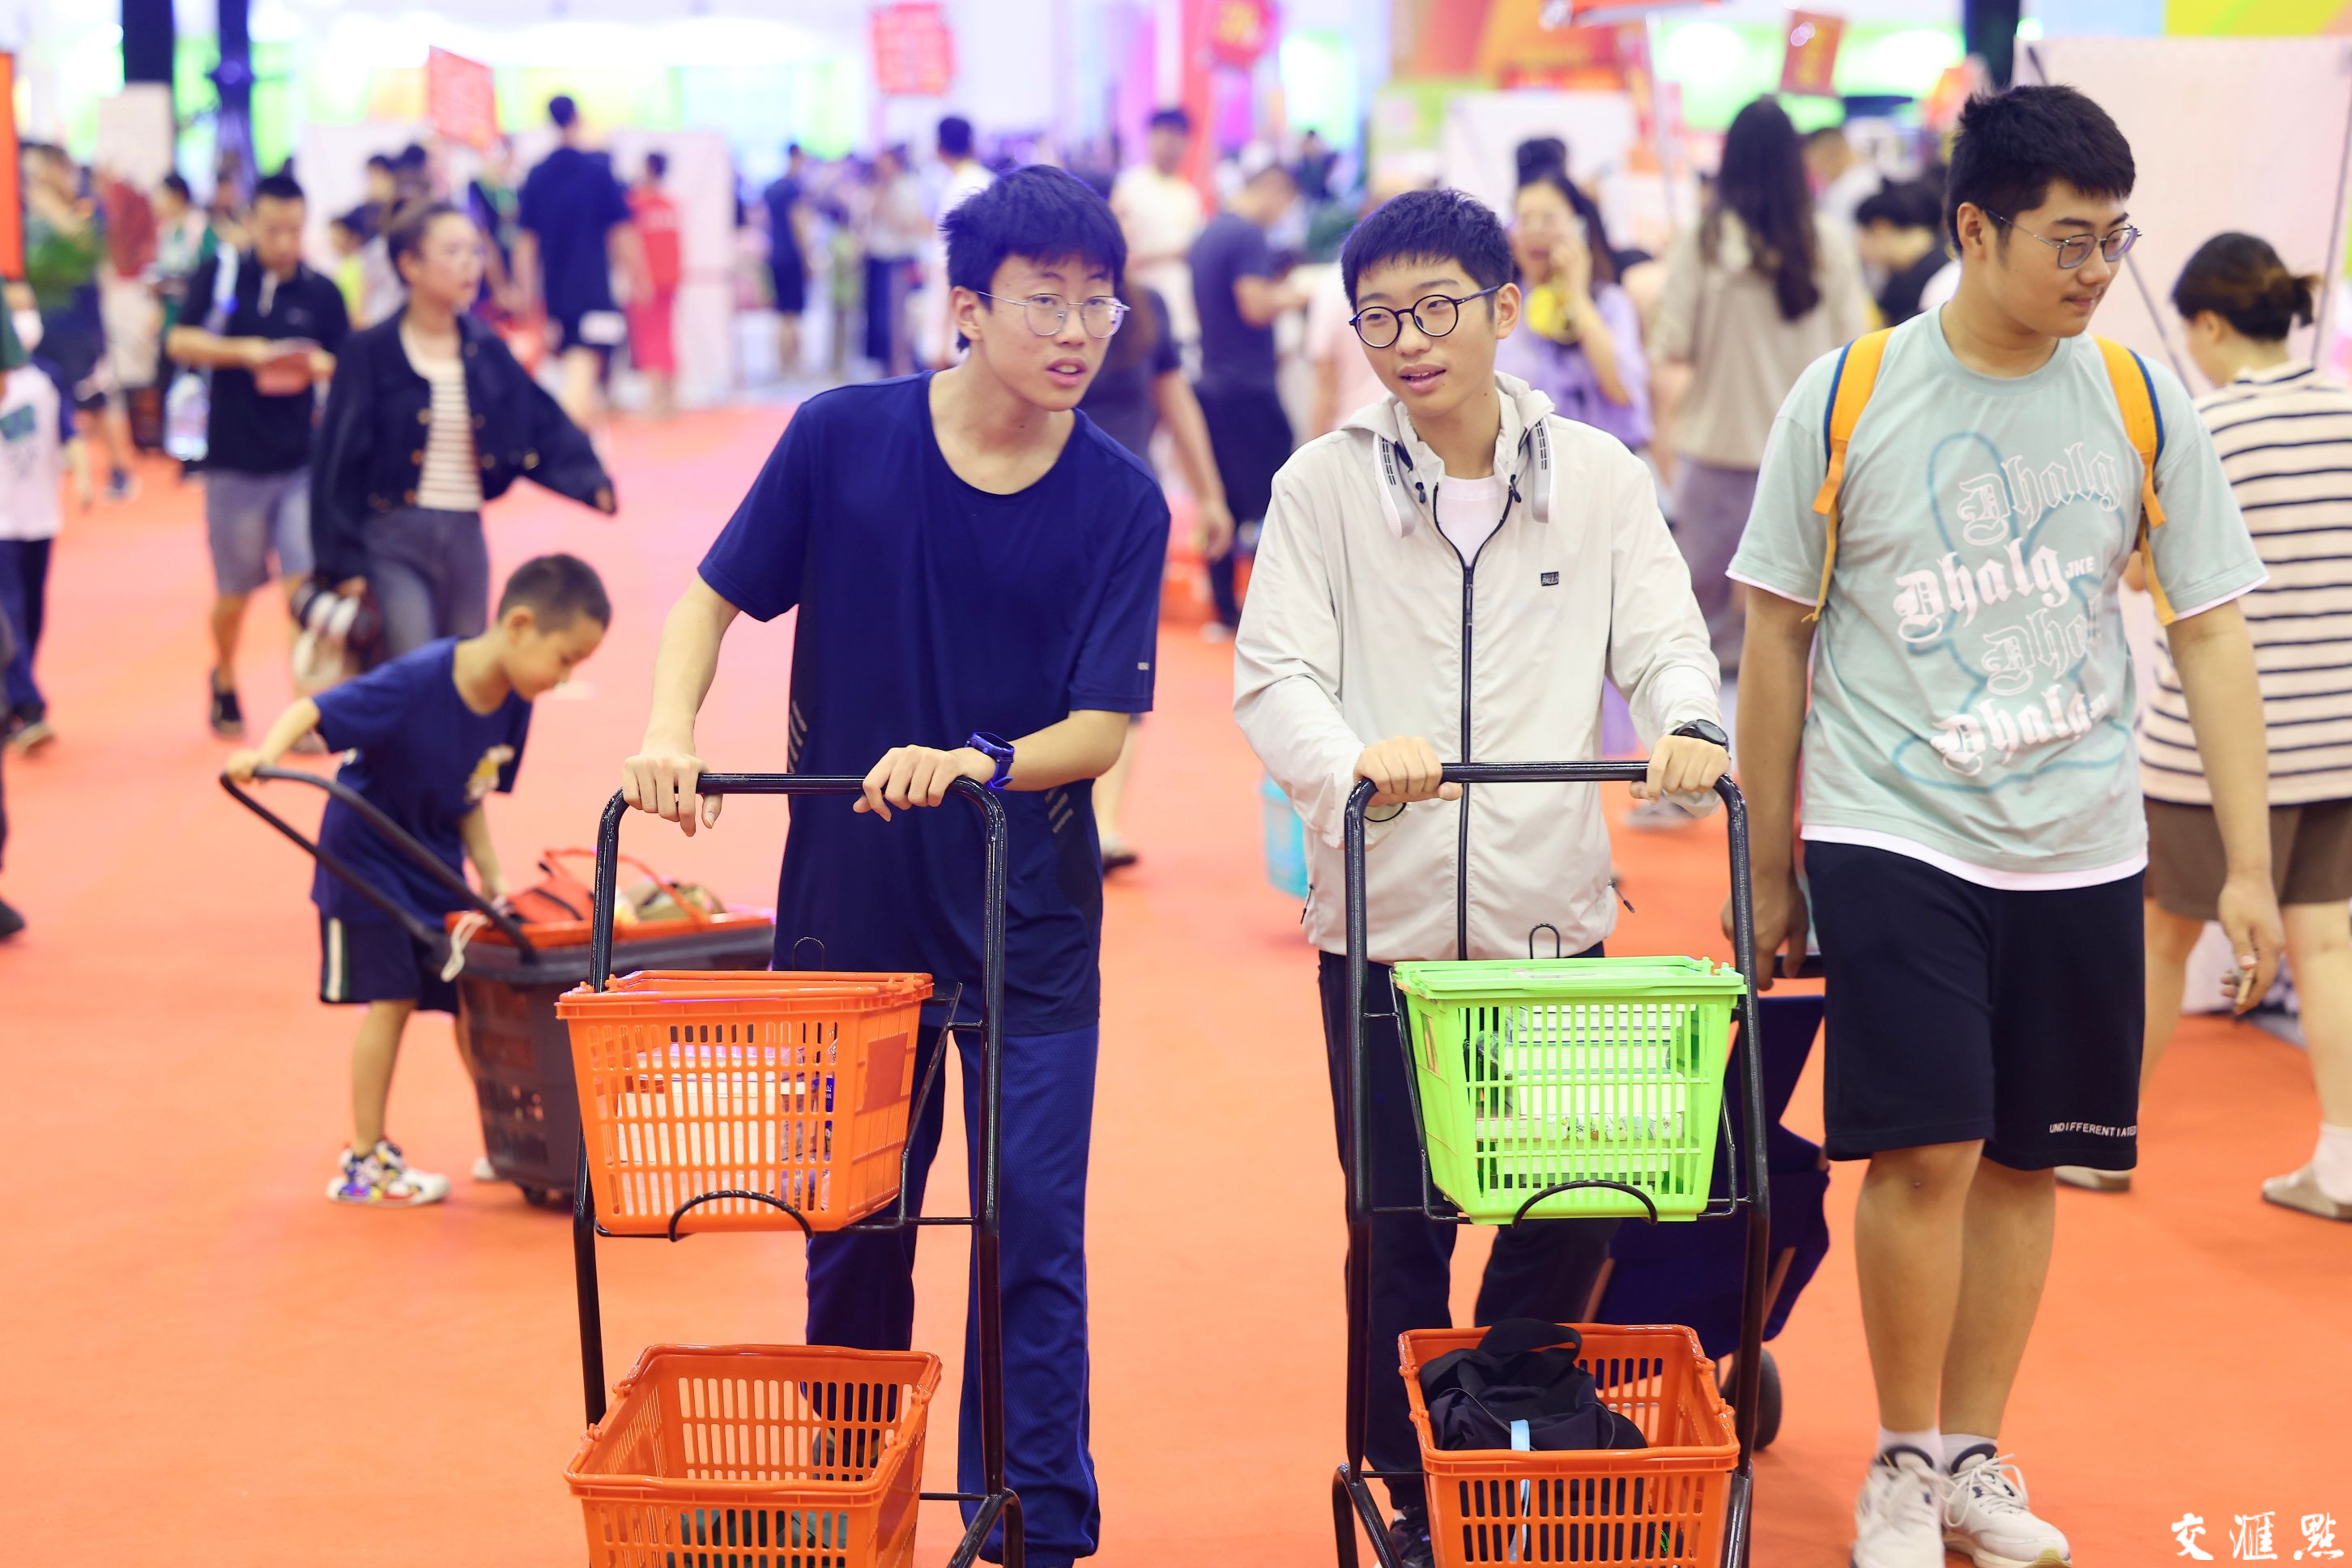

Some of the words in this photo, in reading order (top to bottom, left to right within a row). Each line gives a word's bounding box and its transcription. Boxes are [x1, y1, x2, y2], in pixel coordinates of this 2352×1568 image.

[1956, 441, 2122, 546] Dhalg
[1893, 537, 2070, 643] Dhalg
[2065, 556, 2094, 578] JKE
